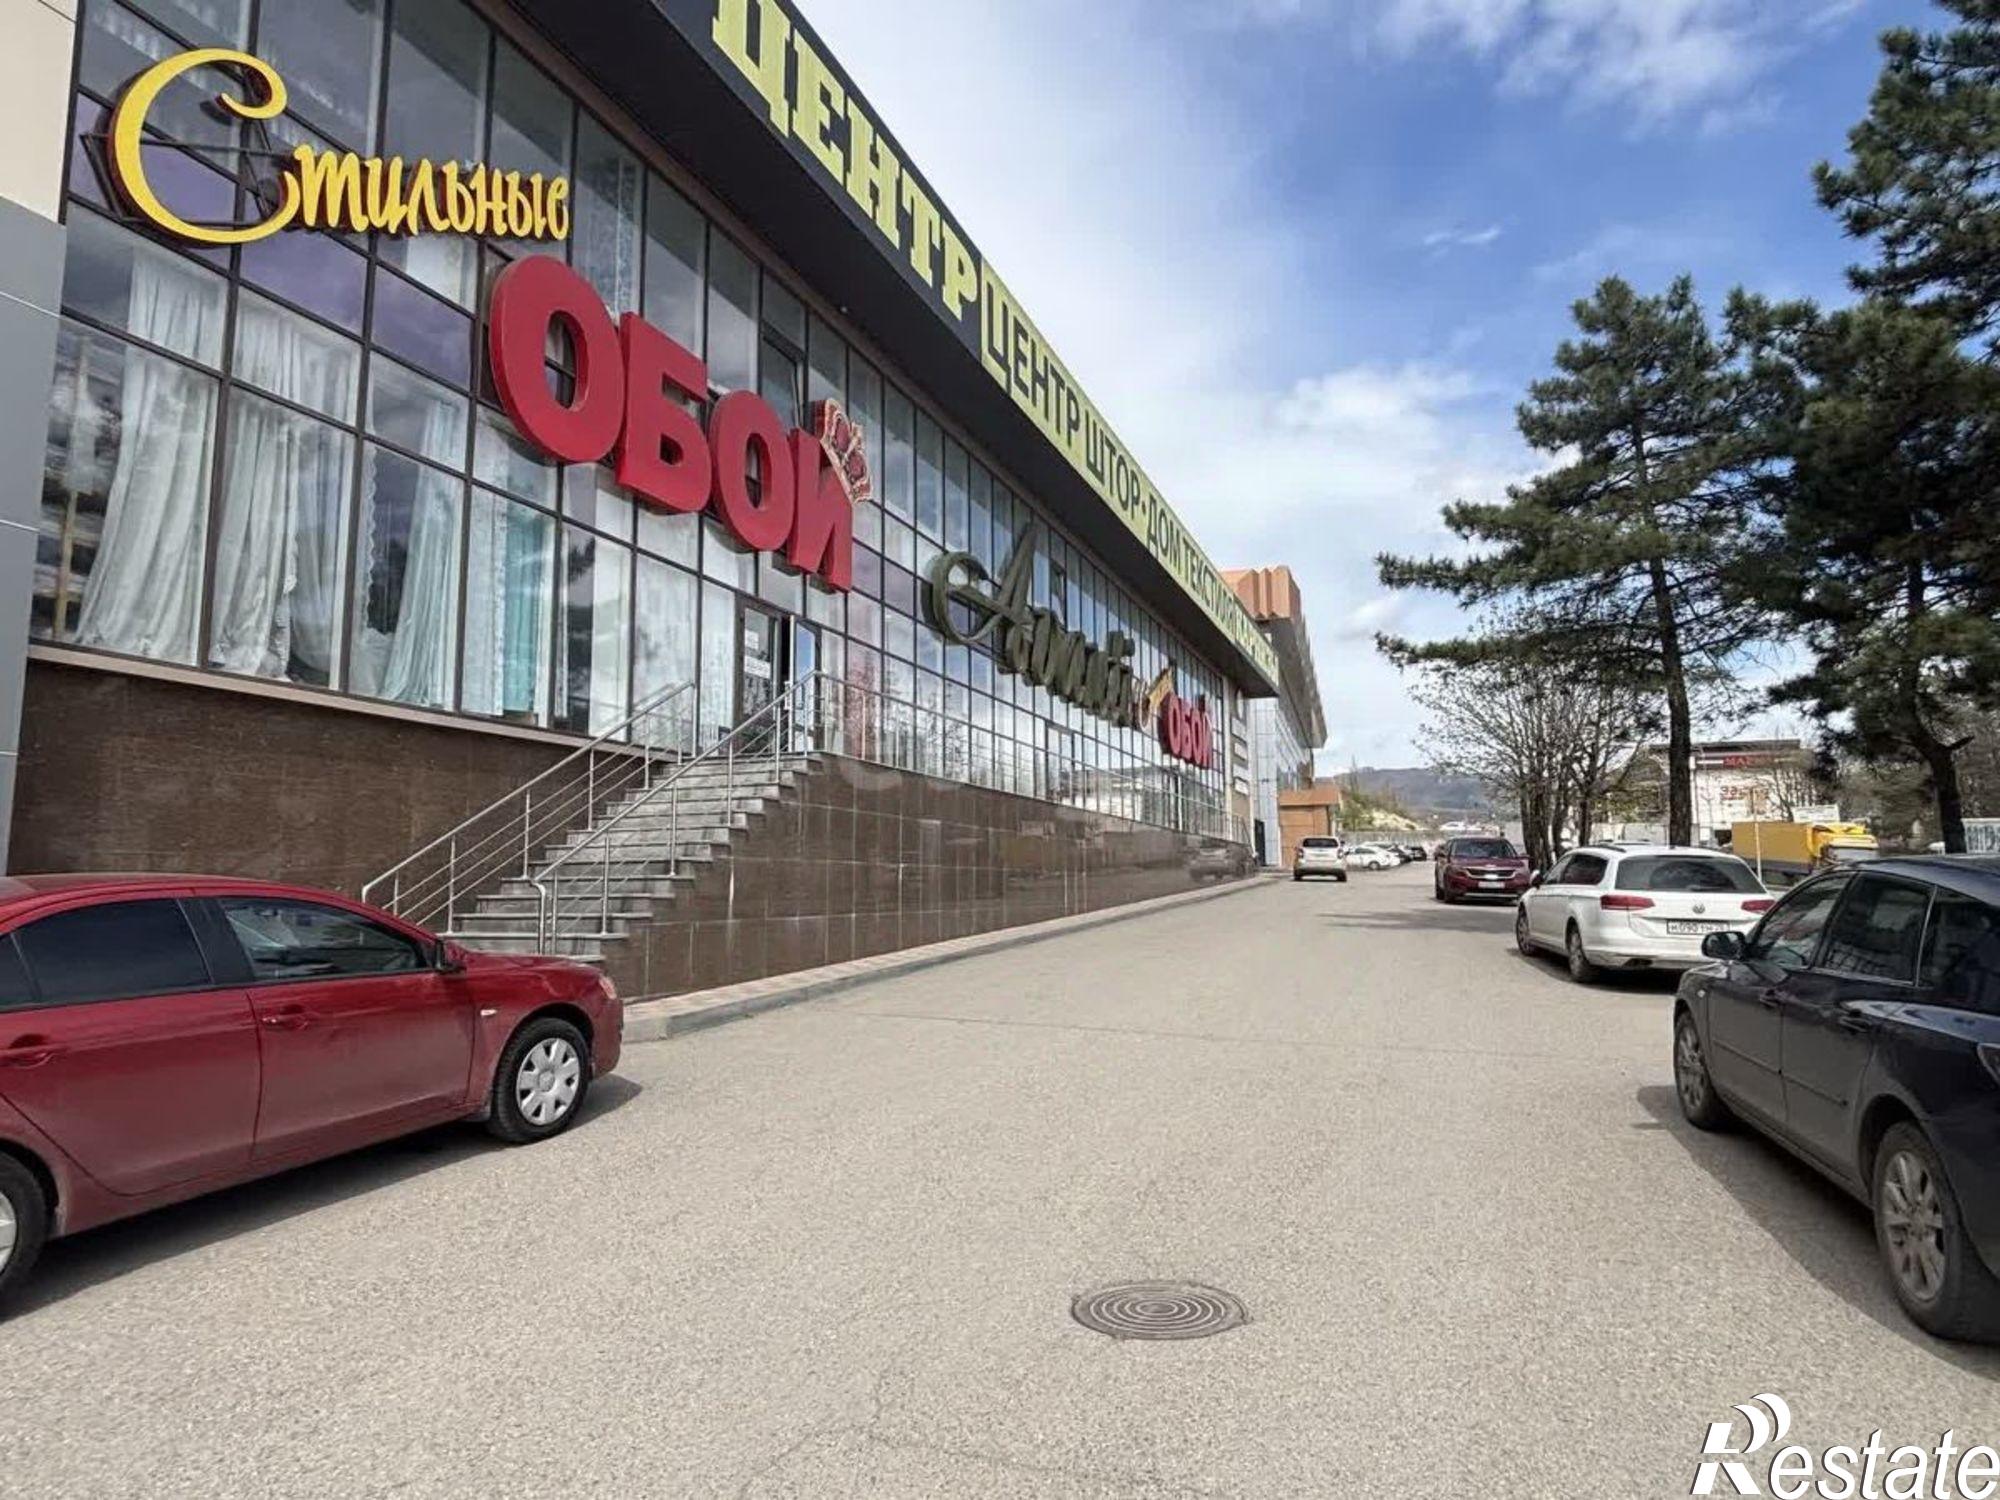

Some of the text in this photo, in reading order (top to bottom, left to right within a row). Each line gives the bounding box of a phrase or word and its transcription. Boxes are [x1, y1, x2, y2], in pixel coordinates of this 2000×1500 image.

[112, 48, 571, 243] Стильные
[713, 0, 978, 321] ЦЕНТР
[986, 281, 1081, 448] ЦЕНТР
[1085, 409, 1141, 520] ШТОР
[1147, 491, 1181, 576] ДОМ
